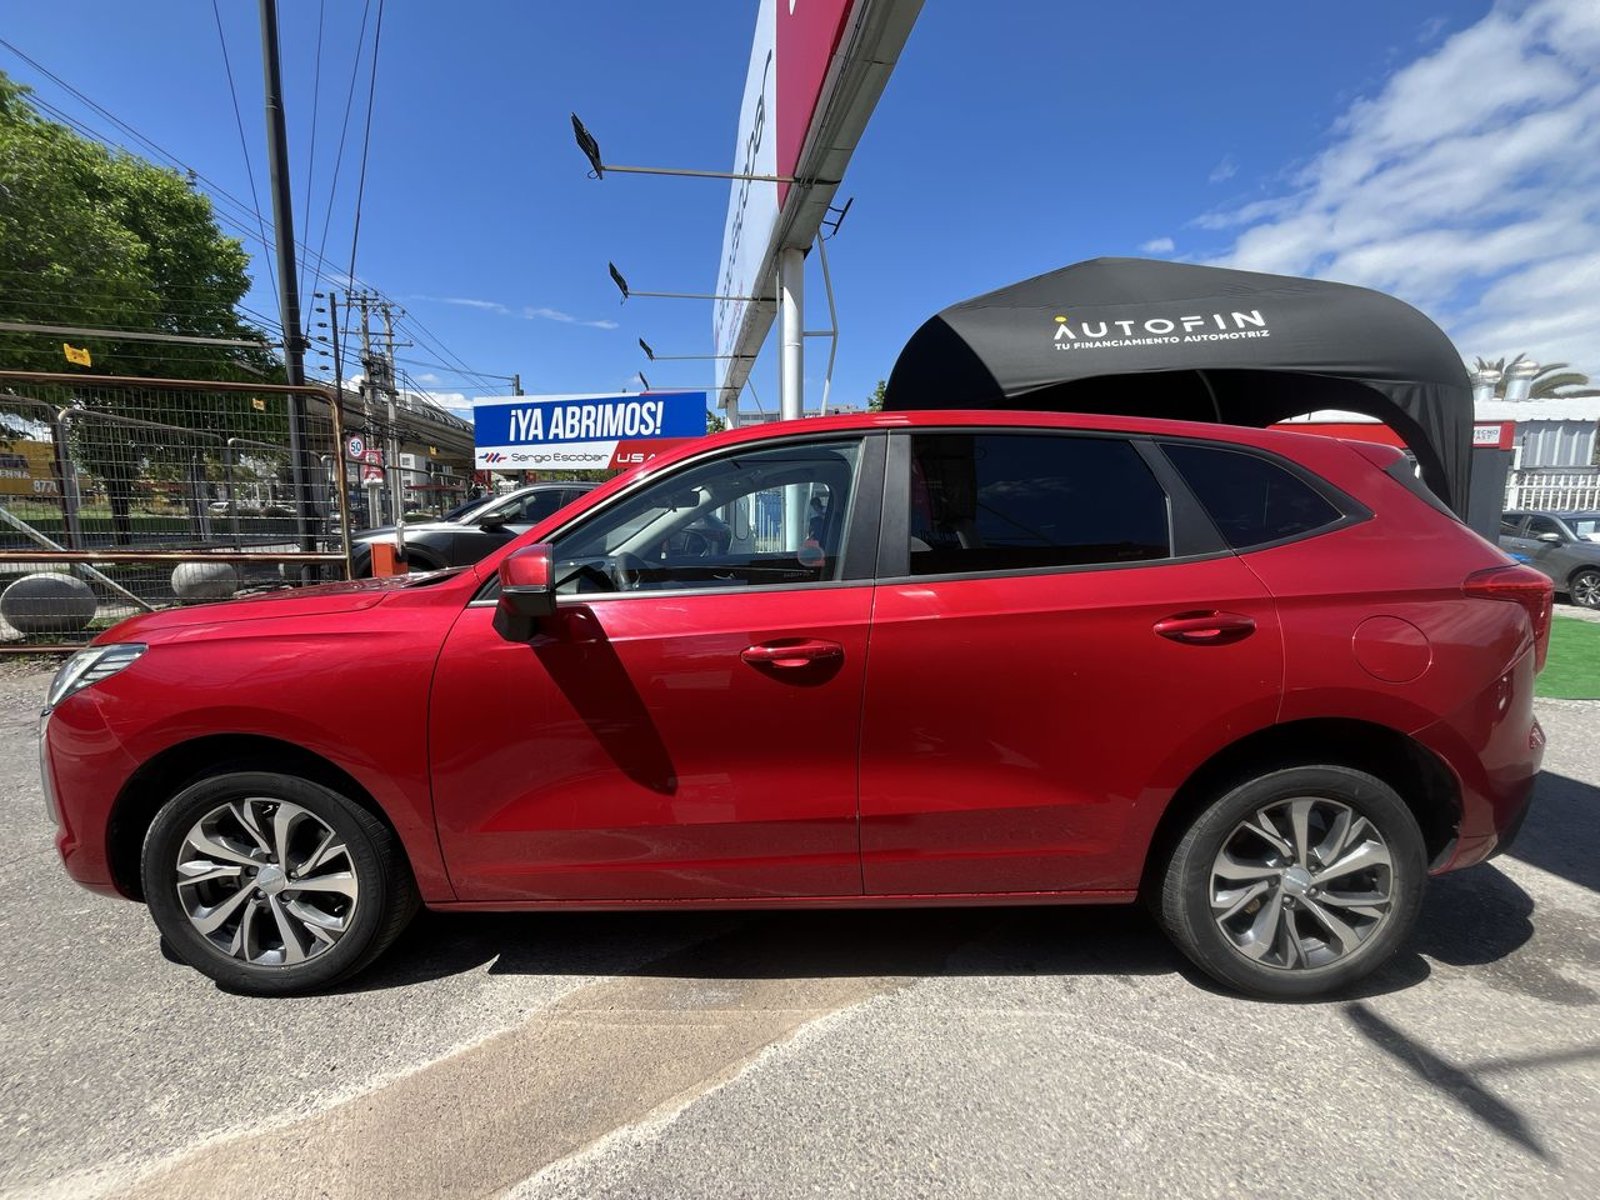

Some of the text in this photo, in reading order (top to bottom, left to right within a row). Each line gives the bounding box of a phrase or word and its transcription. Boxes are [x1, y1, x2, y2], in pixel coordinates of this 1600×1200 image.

[1053, 310, 1266, 340] AUTOFIN
[1055, 329, 1270, 350] TU FINANCIAMIENTO AUTOMOTRIZ
[548, 401, 665, 440] ABRIMOS!
[351, 441, 361, 451] 50
[553, 452, 609, 462] Escobar
